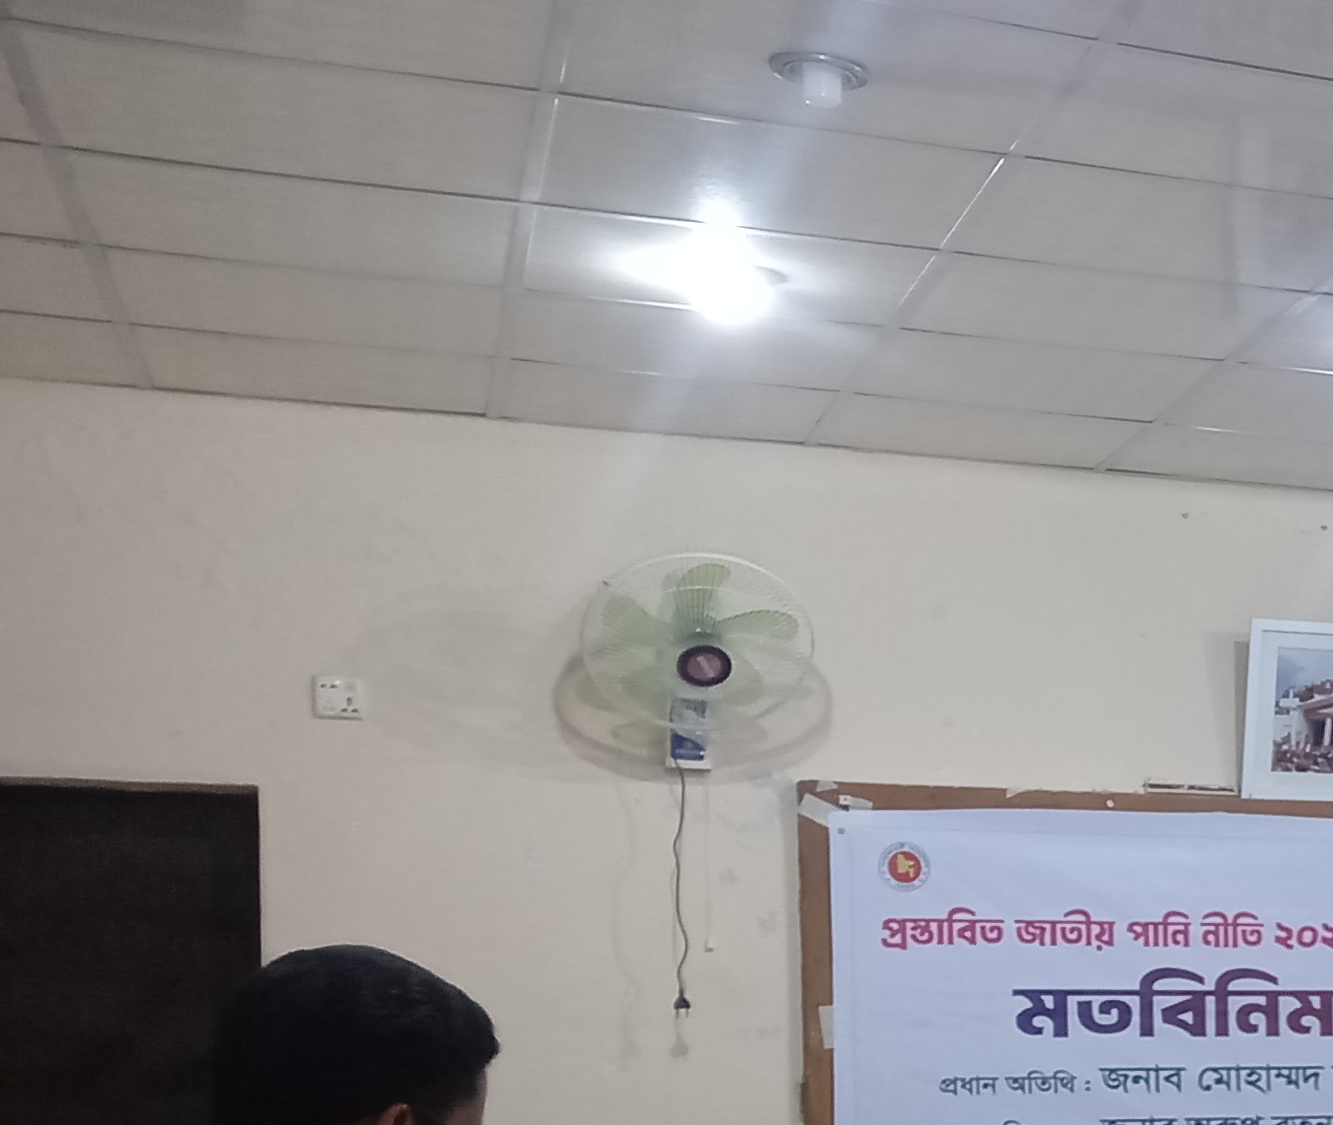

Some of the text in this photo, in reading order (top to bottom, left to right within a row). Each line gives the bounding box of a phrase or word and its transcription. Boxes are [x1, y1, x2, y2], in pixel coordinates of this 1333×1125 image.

[880, 906, 1005, 951] প্রস্তাবিত
[1013, 908, 1116, 952] জাতীয়
[1126, 910, 1192, 948] পানি
[1199, 911, 1265, 949] নীতি
[938, 1075, 1000, 1096] প্রধান
[1003, 1069, 1078, 1095] অতিথি
[1098, 1064, 1187, 1094] জনাব
[1197, 1063, 1326, 1094] মোহাম্মদ
